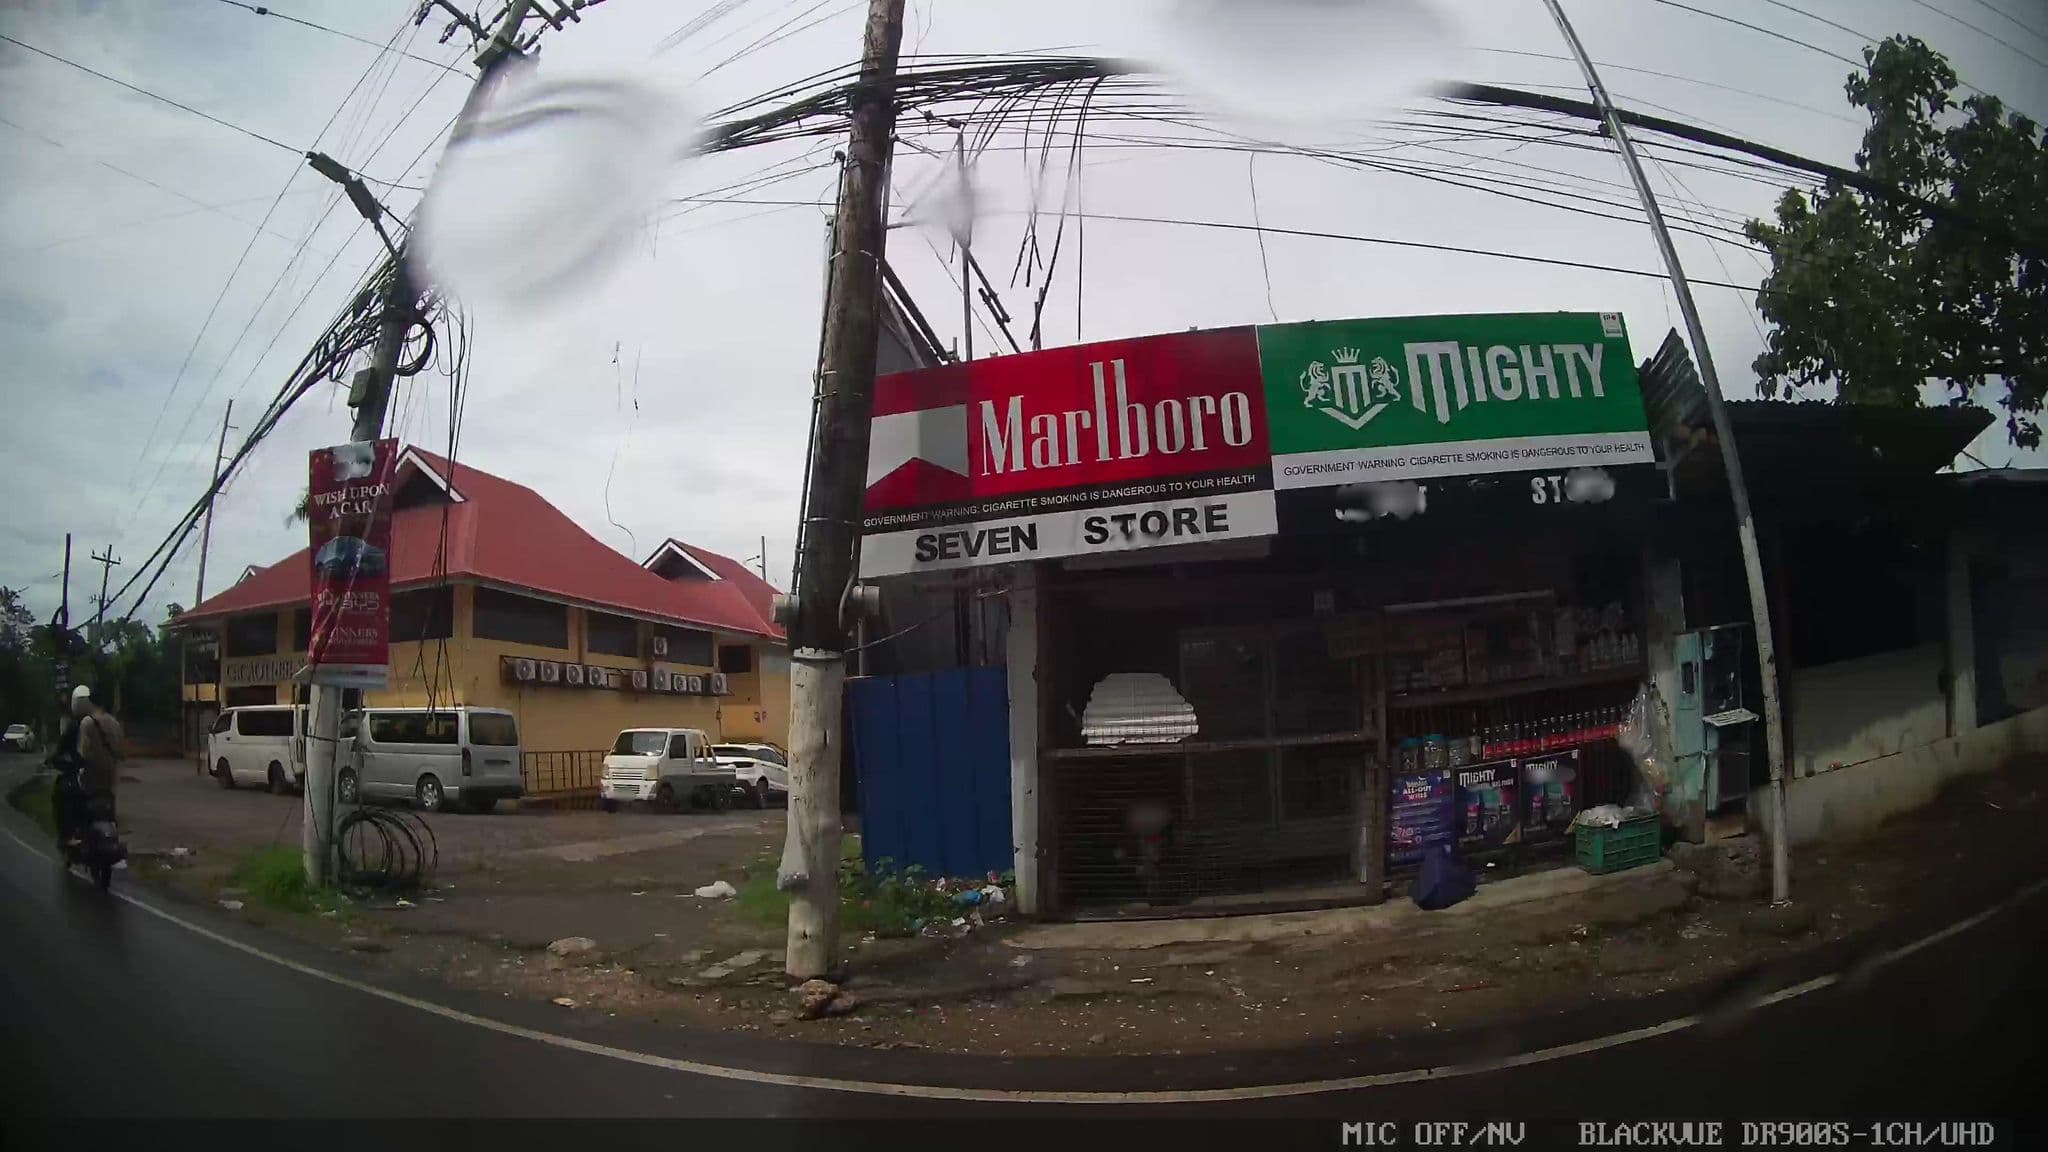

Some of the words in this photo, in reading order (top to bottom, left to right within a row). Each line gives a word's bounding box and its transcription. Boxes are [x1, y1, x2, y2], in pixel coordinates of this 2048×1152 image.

[1404, 341, 1605, 424] MIGHTY
[979, 358, 1252, 476] Marlboro
[1284, 462, 1355, 476] GOVERNMENT
[1410, 454, 1463, 466] CIGARETTE
[1466, 450, 1509, 462] SMOKING
[1511, 451, 1519, 459] IS
[1522, 446, 1575, 458] DANGEROUS
[1577, 446, 1588, 455] TO
[1590, 444, 1612, 454] YOUR
[1615, 443, 1644, 452] HEALTH
[313, 487, 346, 507] WISH
[350, 483, 390, 500] UPON
[329, 506, 340, 520] A
[341, 500, 372, 514] CAR
[864, 512, 928, 527] GOVERNMENT
[983, 498, 1037, 513] CIGARETTE
[1040, 492, 1086, 506] SMOKING
[1090, 491, 1099, 500] IS
[1102, 484, 1167, 499] DANGEROUS
[1169, 482, 1183, 491] TO
[1185, 478, 1214, 490] YOUR
[1217, 474, 1255, 487] HEALTH
[915, 523, 1038, 562] SEVEN
[1084, 504, 1230, 546] STORE
[1459, 769, 1496, 788] MIGHTY
